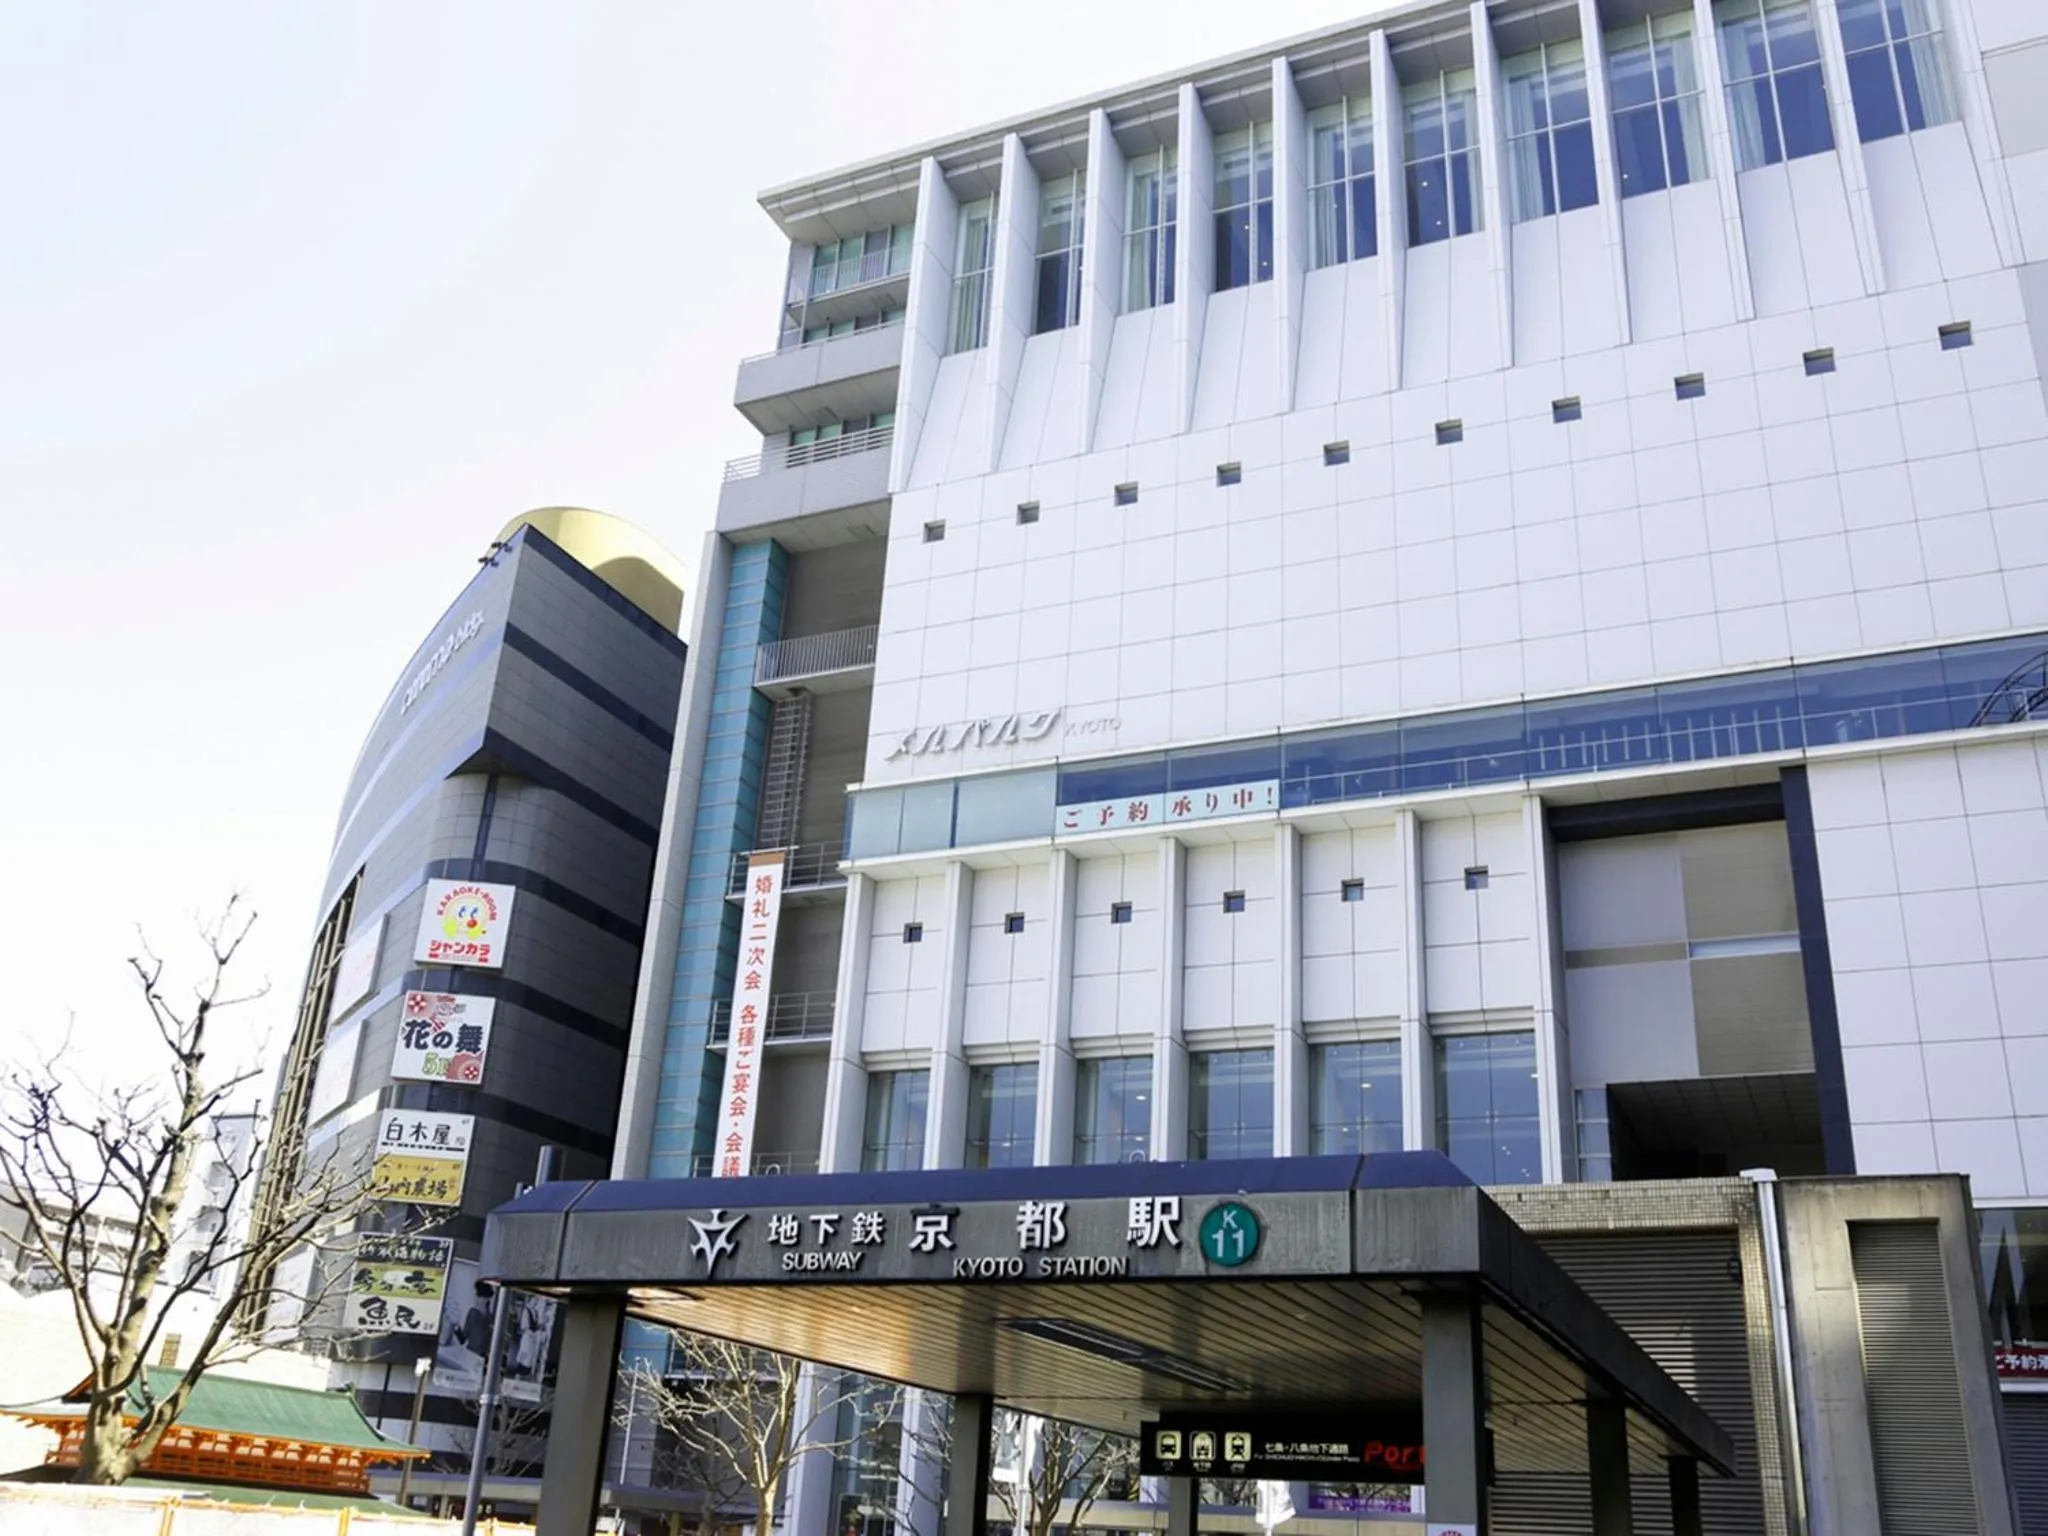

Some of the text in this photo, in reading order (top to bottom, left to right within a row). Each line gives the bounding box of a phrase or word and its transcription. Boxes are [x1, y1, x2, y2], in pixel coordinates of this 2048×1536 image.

[743, 874, 773, 991] 婚礼二次会
[429, 940, 491, 957] ジャンカラ
[403, 1019, 484, 1054] 花の舞
[385, 1117, 451, 1145] 白木屋
[767, 1196, 1182, 1253] 地下鉄 京都駅
[1222, 1209, 1238, 1229] K
[1211, 1228, 1245, 1258] 11
[780, 1251, 1130, 1277] SUBWAY KYOTO STATION
[358, 1296, 421, 1330] 魚民
